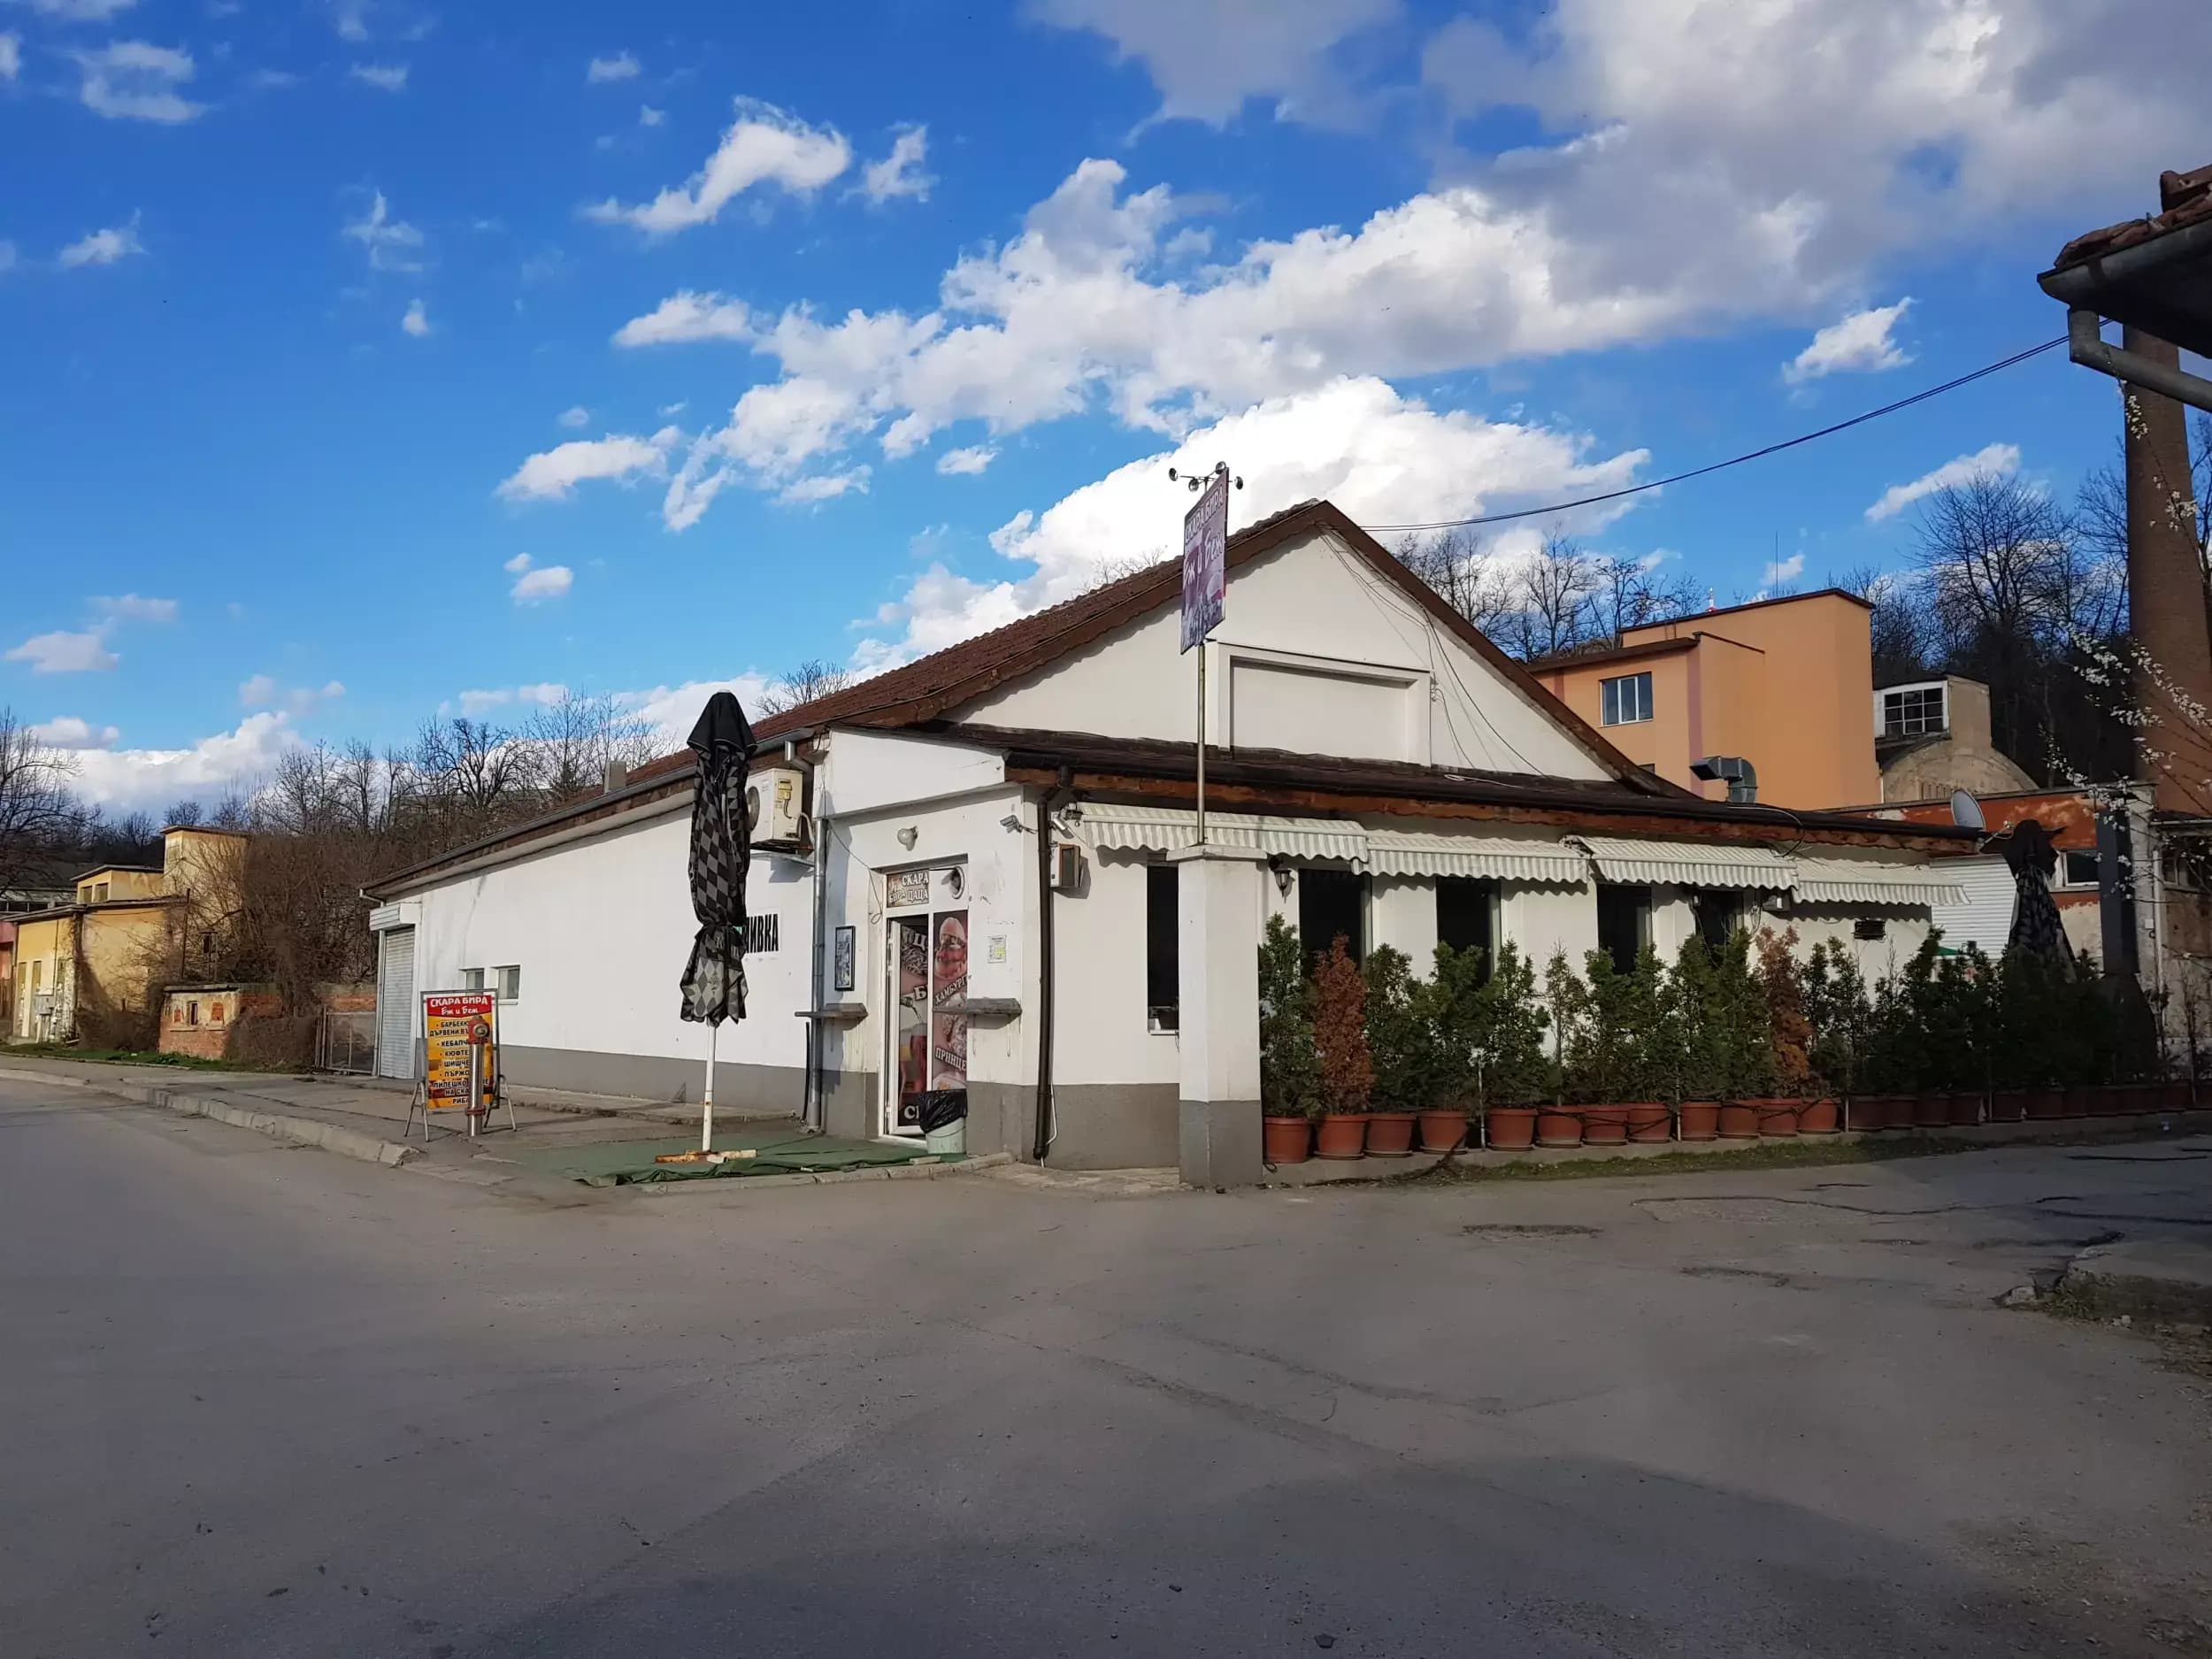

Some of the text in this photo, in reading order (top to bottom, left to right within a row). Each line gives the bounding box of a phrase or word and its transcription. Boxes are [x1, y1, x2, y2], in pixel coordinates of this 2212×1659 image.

[1185, 484, 1224, 545] СКАРА БИРА
[902, 872, 929, 887] СКАРА
[908, 887, 929, 902] ЦАЦА
[430, 996, 488, 1007] СКАРА БИРА
